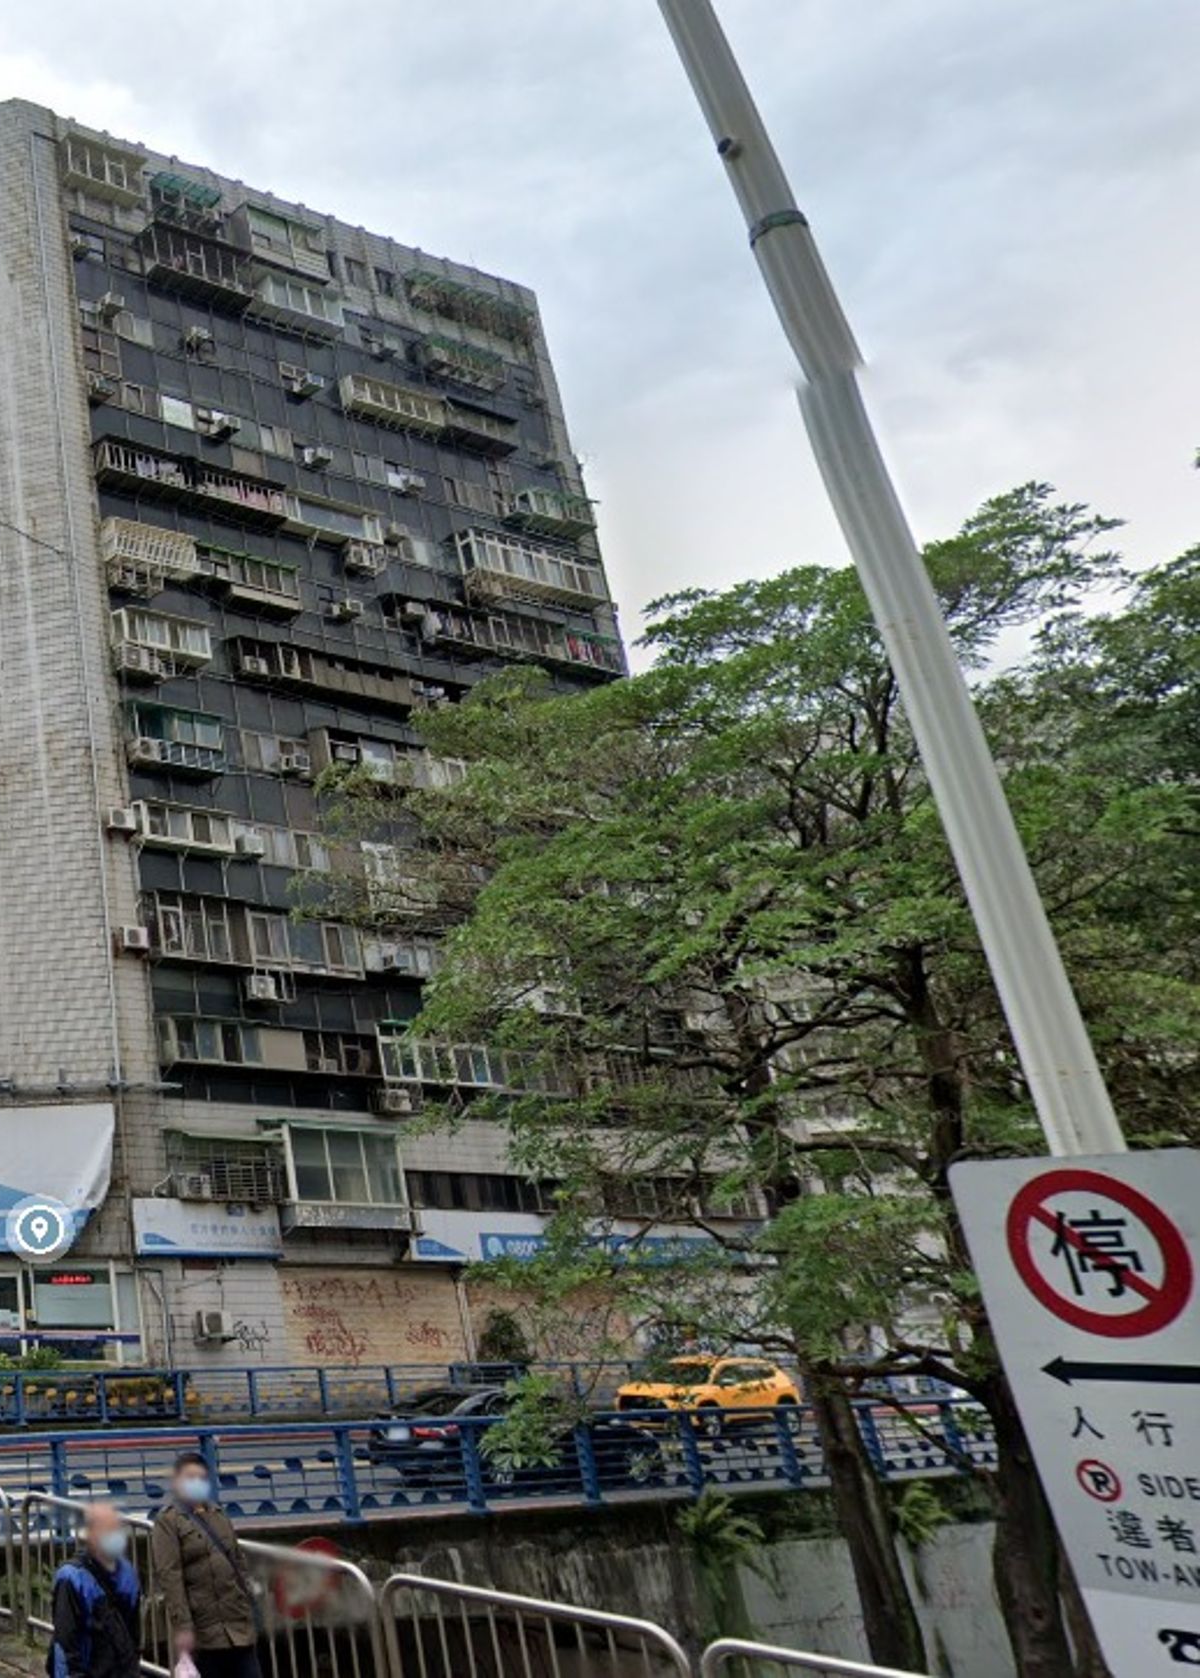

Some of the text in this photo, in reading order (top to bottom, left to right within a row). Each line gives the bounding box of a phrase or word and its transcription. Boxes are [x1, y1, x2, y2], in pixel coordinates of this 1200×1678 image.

[1050, 1209, 1145, 1297] 停
[1071, 1406, 1175, 1447] 人行
[1137, 1473, 1200, 1501] SIDE
[1106, 1510, 1197, 1554] 違者
